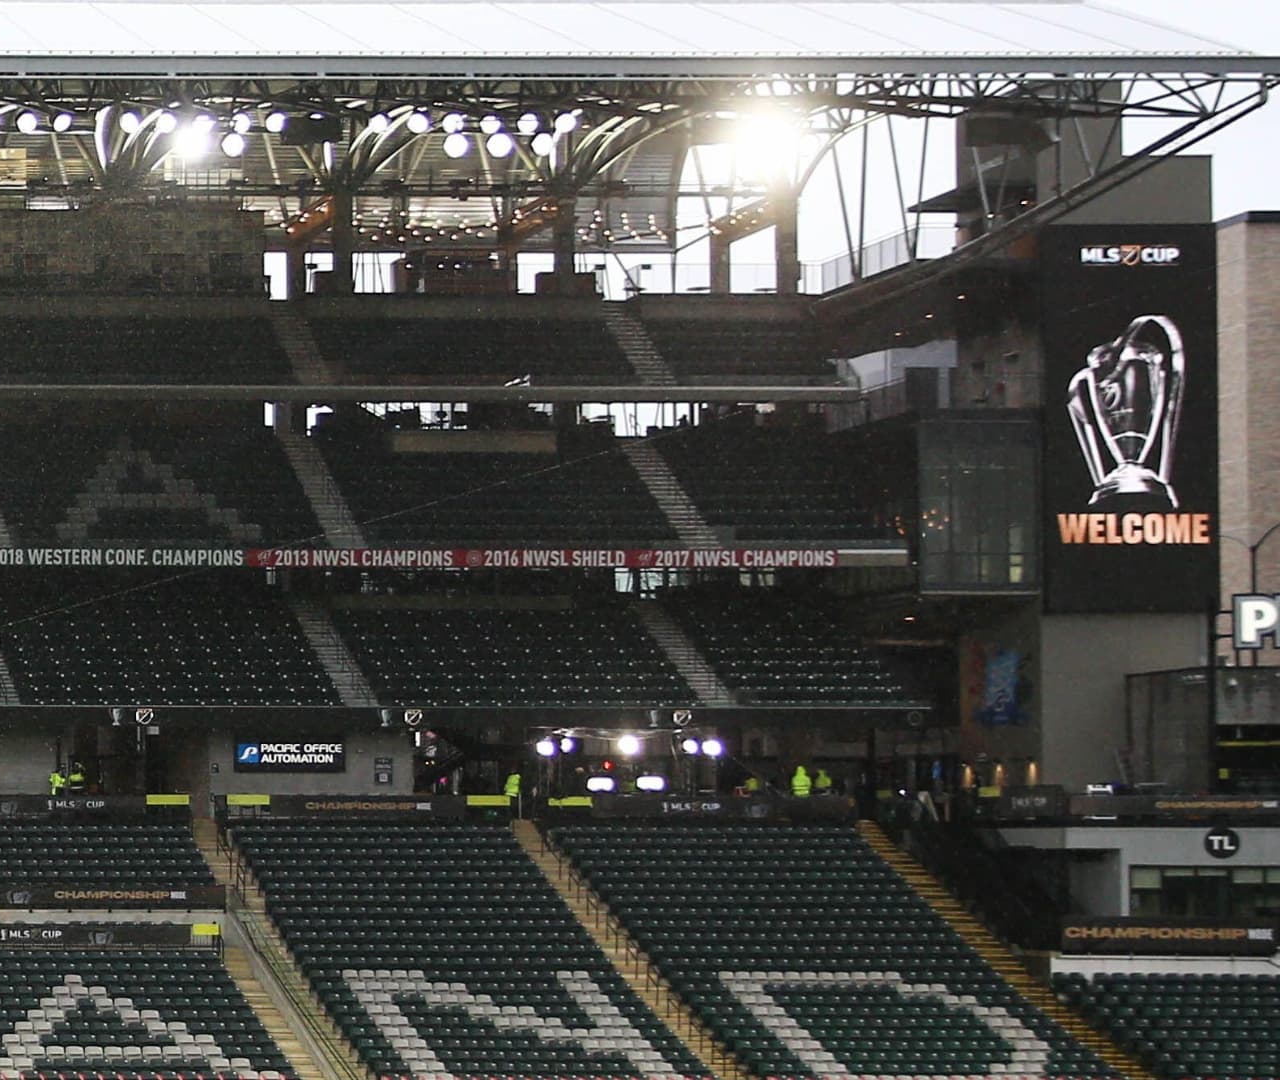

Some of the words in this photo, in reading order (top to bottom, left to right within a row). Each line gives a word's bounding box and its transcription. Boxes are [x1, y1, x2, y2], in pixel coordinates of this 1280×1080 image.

[1081, 246, 1120, 264] MLS
[1140, 246, 1180, 264] CUP
[1057, 512, 1210, 545] WELCOME
[28, 549, 101, 565] WESTERN
[105, 549, 149, 565] CONF.
[152, 550, 243, 566] CHAMPIONS
[275, 550, 308, 566] 2013
[313, 550, 358, 566] NWSL
[362, 550, 452, 566] CHAMPIONS
[484, 550, 518, 566] 2016
[523, 550, 568, 566] NWSL
[572, 550, 625, 566] SHIELD
[656, 550, 688, 566] 2017
[694, 550, 738, 566] NWSL
[743, 550, 835, 566] CHAMPIONS
[261, 744, 300, 753] PACIFIC
[304, 744, 342, 753] OFFICE
[261, 754, 334, 763] AUTOMATION
[56, 800, 75, 809] MLS
[86, 800, 105, 809] CUP
[1209, 836, 1236, 849] TL
[54, 890, 169, 899] CHAMPIONSHIP
[10, 930, 30, 939] MLS
[42, 930, 62, 939] CUP
[1064, 927, 1246, 939] CHAMPIONSHIP
